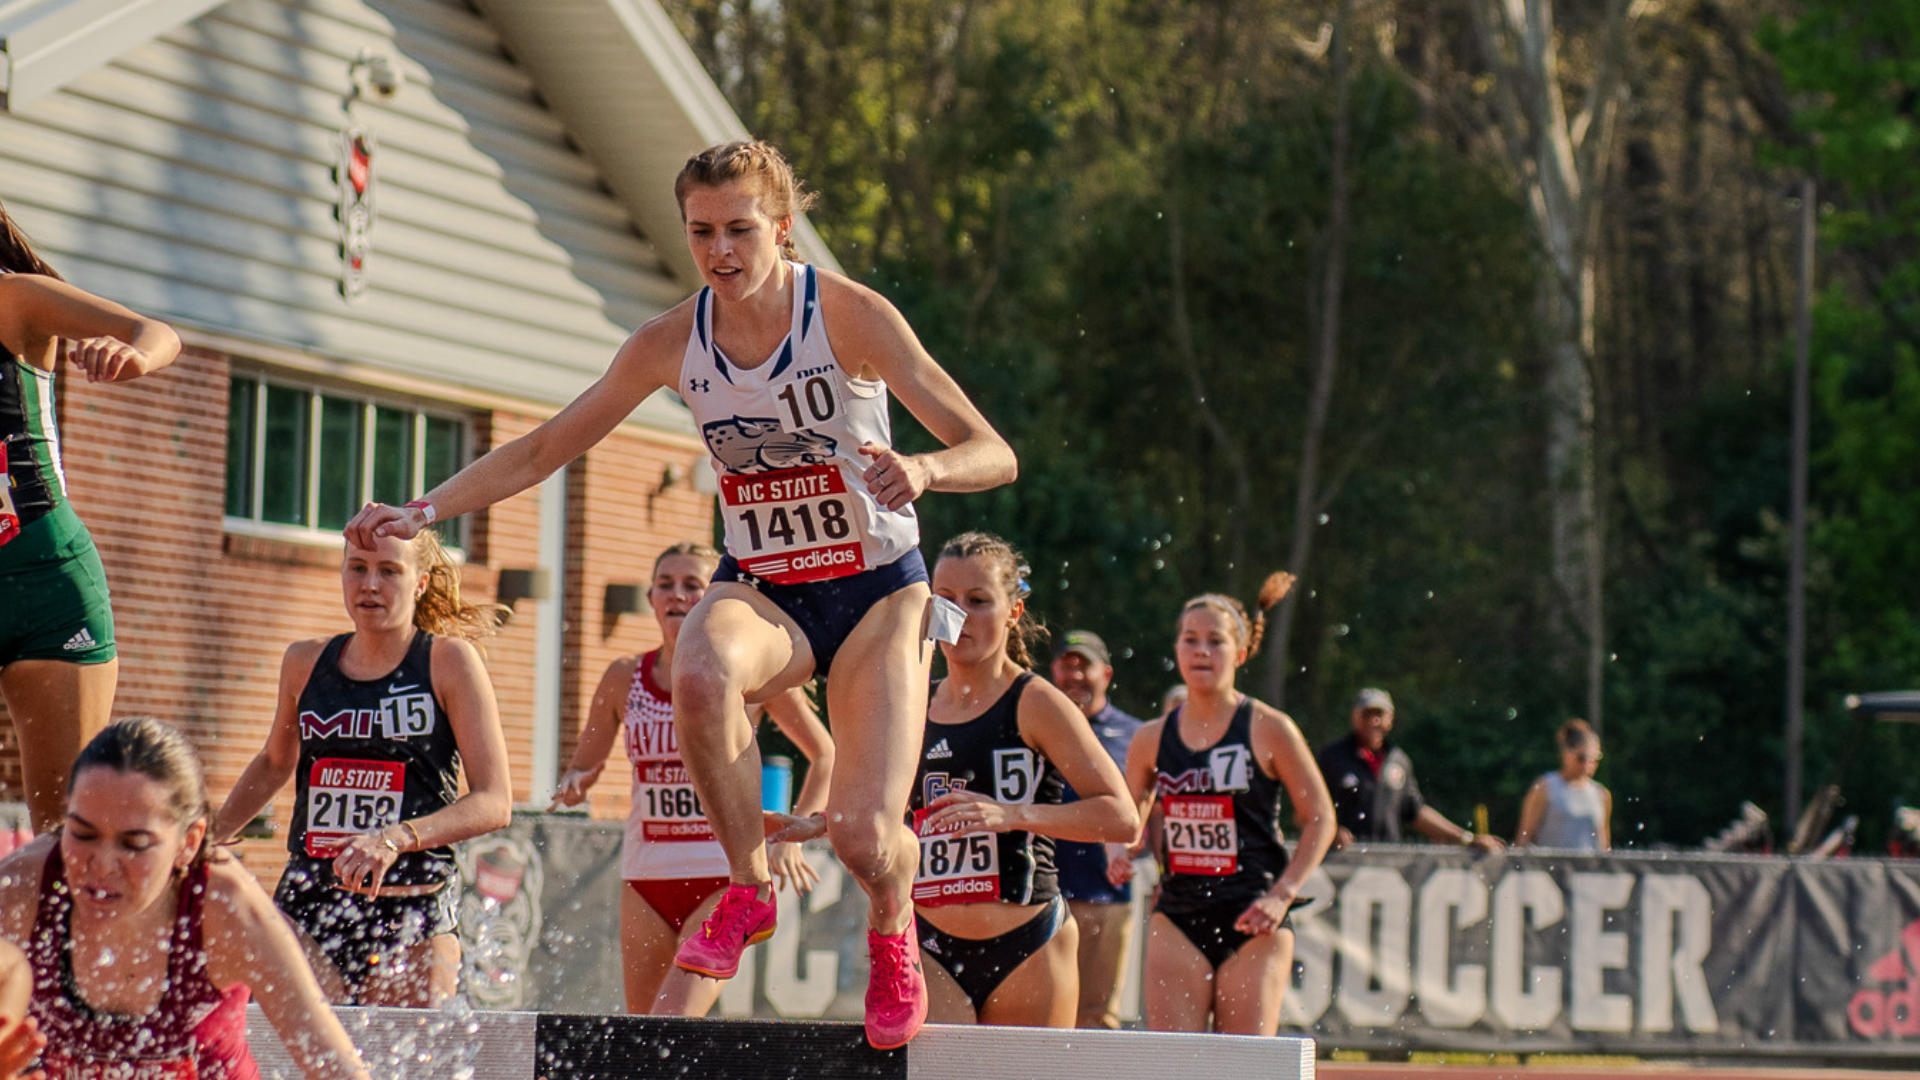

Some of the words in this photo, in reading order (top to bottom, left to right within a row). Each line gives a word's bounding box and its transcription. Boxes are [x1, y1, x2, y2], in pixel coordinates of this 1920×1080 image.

[778, 376, 835, 427] 10
[737, 483, 765, 503] NC
[770, 474, 830, 499] STATE
[740, 499, 849, 551] 1418
[792, 549, 856, 570] adidas
[300, 709, 407, 741] MI
[385, 697, 427, 735] 15
[320, 767, 344, 787] NC
[345, 769, 394, 790] STATE
[665, 767, 689, 783] STA
[1001, 753, 1027, 802] 5
[1217, 750, 1238, 786] 7
[1170, 803, 1187, 816] NC
[1188, 803, 1225, 818] STATE
[1170, 822, 1231, 850] 2158
[919, 835, 991, 877] 1875
[942, 880, 994, 895] adidas
